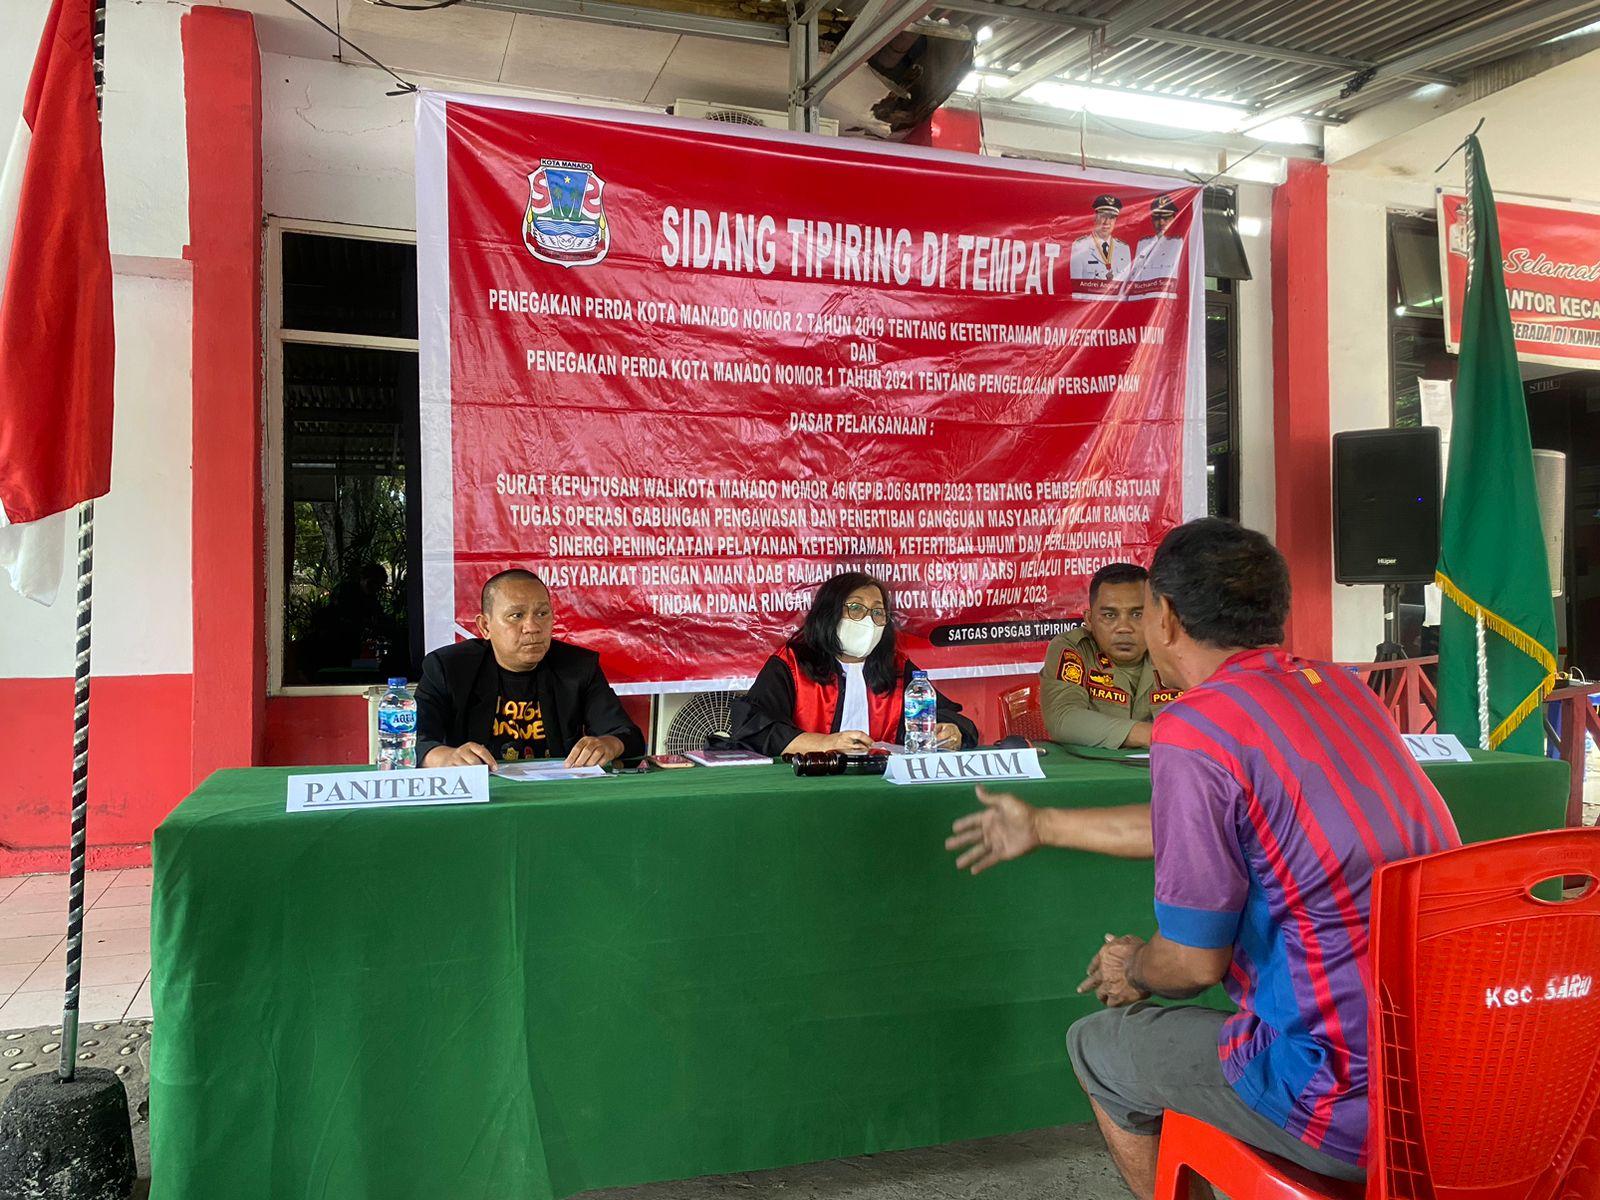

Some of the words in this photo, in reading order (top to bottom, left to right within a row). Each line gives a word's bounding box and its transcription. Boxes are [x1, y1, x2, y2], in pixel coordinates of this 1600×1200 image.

[562, 161, 592, 169] MANADO
[661, 205, 776, 274] SIDANG
[787, 218, 913, 285] TIPIRING
[921, 231, 949, 288] DI
[958, 234, 1060, 295] TEMPAT
[1502, 248, 1600, 282] Selamat
[489, 289, 581, 316] PENEGAKAN
[585, 297, 633, 321] PERDA
[637, 301, 676, 324] KOTA
[680, 304, 738, 328] MANADO
[743, 309, 791, 331] NOMOR
[796, 312, 803, 332] 2
[807, 314, 851, 335] TAHUN
[855, 316, 884, 337] 2019
[888, 318, 946, 341] TENTANG
[951, 322, 1041, 344] KETENTRAMAN
[1044, 327, 1066, 345] DAN
[1068, 326, 1136, 347] KETERTIBAN
[1505, 289, 1556, 314] NTOR
[1560, 296, 1600, 319] KECA
[1554, 326, 1568, 344] DI
[1568, 327, 1600, 347] KAWA
[850, 342, 877, 363] DAN
[527, 350, 616, 376] PENEGAKAN
[621, 356, 667, 378] PERDA
[671, 359, 709, 381] KOTA
[713, 361, 770, 383] MANADO
[775, 364, 823, 386] NOMOR
[827, 368, 833, 386] 1
[838, 368, 882, 389] TAHUN
[885, 370, 913, 390] 2021
[918, 371, 975, 392] TENTANG
[979, 374, 1055, 395] PENGELOLAAN
[790, 412, 833, 433] DASAR
[836, 414, 927, 435] PELAKSANAAN
[496, 473, 546, 495] SURAT
[552, 475, 639, 497] KEPUTUSAN
[643, 478, 715, 499] WALIKOTA
[720, 479, 777, 499] MANADO
[781, 479, 828, 500] NOMOR
[976, 481, 1032, 501] TENTANG
[1036, 480, 1112, 500] PEMBENTUKAN
[1115, 478, 1160, 496] SATUAN
[510, 504, 561, 526] TUGAS
[566, 505, 627, 526] OPERASI
[632, 507, 710, 527] GABUNGAN
[715, 508, 806, 528] PENGAWASAN
[811, 508, 836, 528] DAN
[840, 509, 914, 528] PENERTIBAN
[918, 509, 984, 529] GANGGUAN
[988, 508, 1067, 528] MASYARAKAT
[1068, 506, 1100, 525] DALAM
[1104, 504, 1150, 522] RANGKA
[549, 536, 608, 556] SINERGI
[613, 536, 712, 556] PENINGKATAN
[718, 536, 797, 556] PELAYANAN
[802, 536, 896, 558] KETENTRAMAN,
[900, 536, 974, 555] KETERTIBAN
[977, 536, 1014, 554] UMUM
[1019, 535, 1040, 552] DAN
[1043, 531, 1122, 551] PERLINDUNGAN
[538, 566, 637, 587] MASYARAKAT
[642, 565, 699, 585] DENGAN
[704, 565, 743, 584] AMAN
[747, 564, 783, 584] ADAB
[787, 564, 832, 584] RAMAH
[864, 563, 920, 582] SIMPATIK
[924, 563, 978, 584] (SENYUM
[982, 562, 1017, 584] AARS)
[1020, 558, 1061, 579] MELALUI
[651, 594, 702, 615] TINDAK
[707, 593, 757, 613] PIDANA
[761, 592, 812, 612] RINGAN
[896, 591, 928, 609] KOTA
[932, 589, 982, 611] MANADO
[986, 587, 1021, 607] TAHUN
[1023, 585, 1047, 604] 2023
[948, 627, 988, 642] SATGAS
[991, 624, 1031, 638] OPSGAB
[1034, 622, 1078, 636] TIPIRING
[1153, 691, 1184, 702] POL-P
[393, 714, 415, 724] AQUA
[905, 752, 1025, 780] HAKIM
[304, 775, 472, 803] PANITERA
